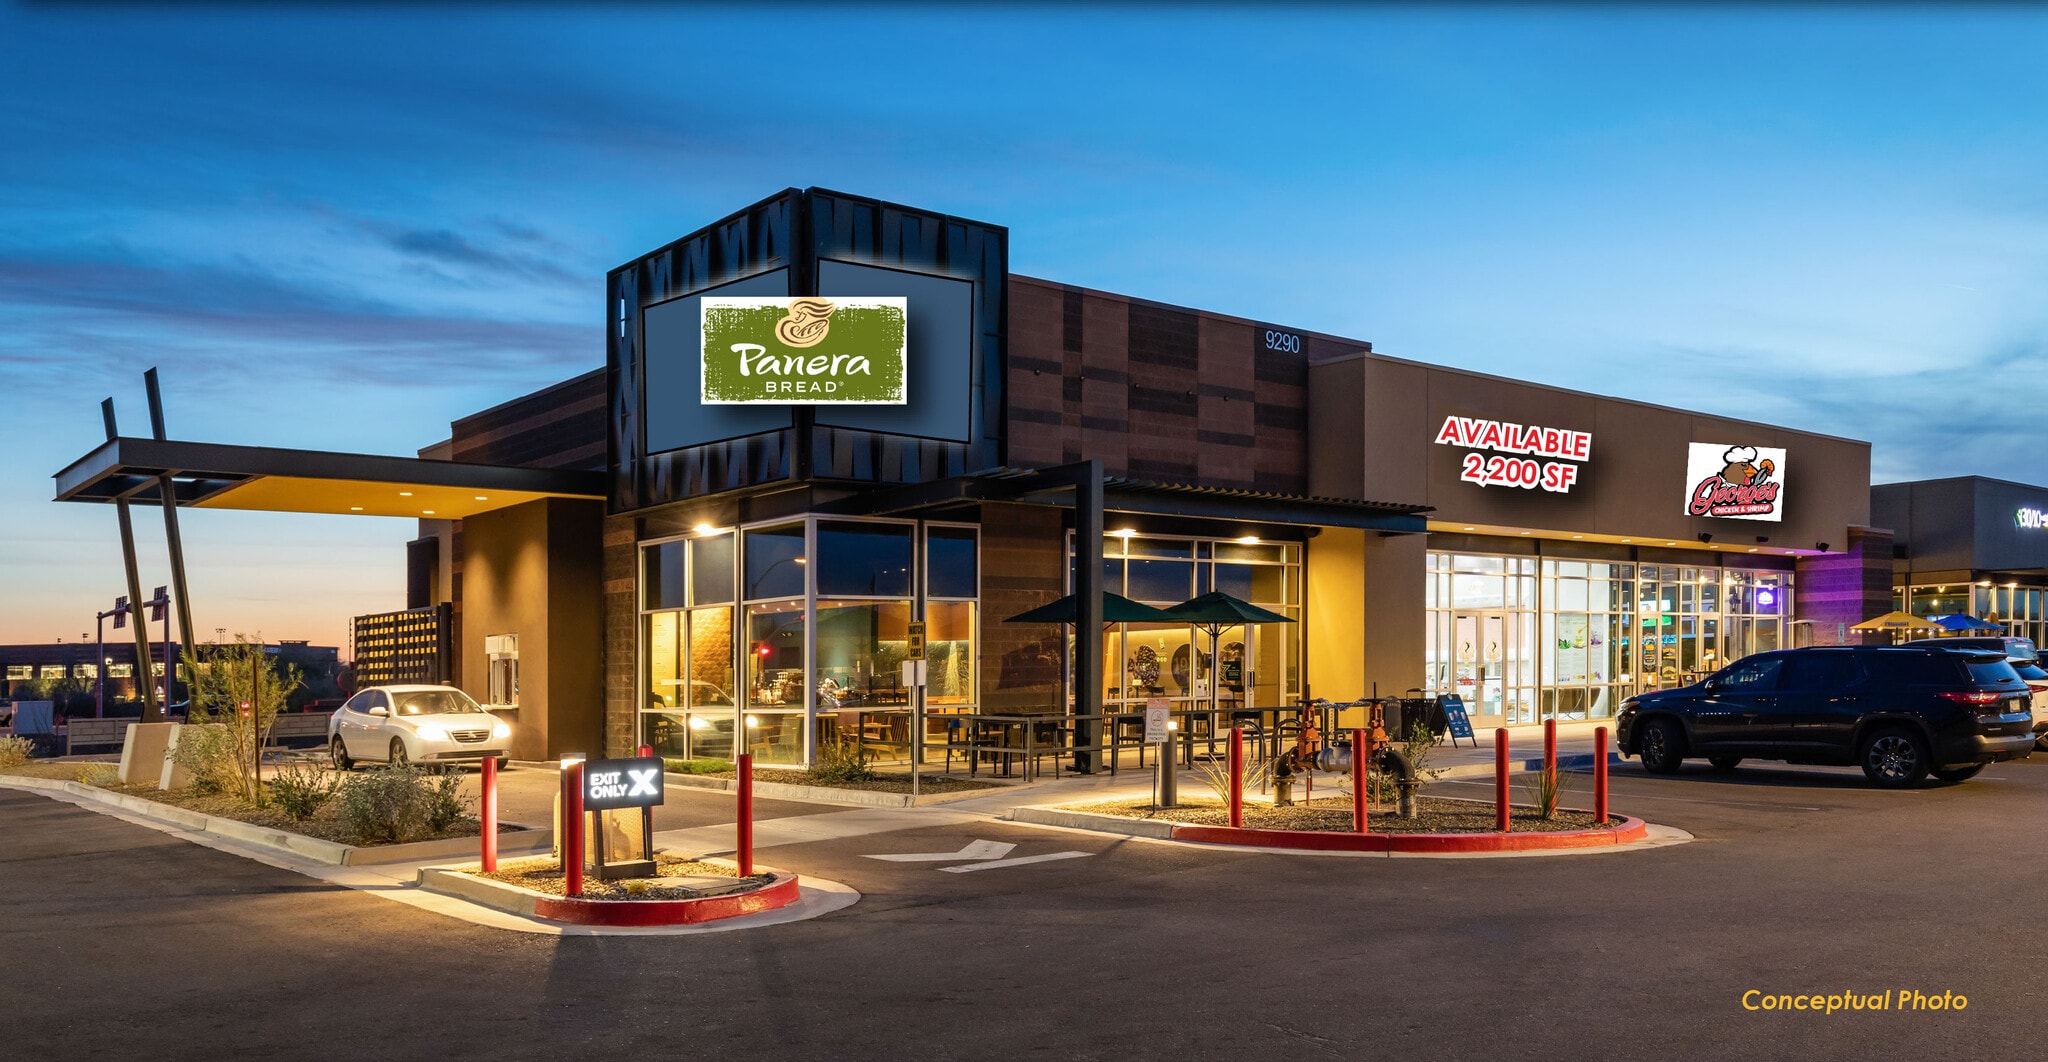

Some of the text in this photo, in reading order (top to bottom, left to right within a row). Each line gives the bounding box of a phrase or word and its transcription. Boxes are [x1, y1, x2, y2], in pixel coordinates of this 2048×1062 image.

[1265, 330, 1300, 354] 9290
[730, 342, 871, 377] Panera
[1439, 418, 1589, 458] AVAILABLE
[1464, 455, 1575, 489] 2,200 SF
[1690, 477, 1779, 515] George's
[1714, 506, 1739, 514] CHICKEN
[1746, 505, 1770, 513] SHRIMP
[908, 625, 924, 635] WATCH
[911, 636, 920, 647] FOR
[910, 648, 922, 658] CARS
[590, 772, 621, 786] EXIT
[590, 784, 628, 799] ONLY
